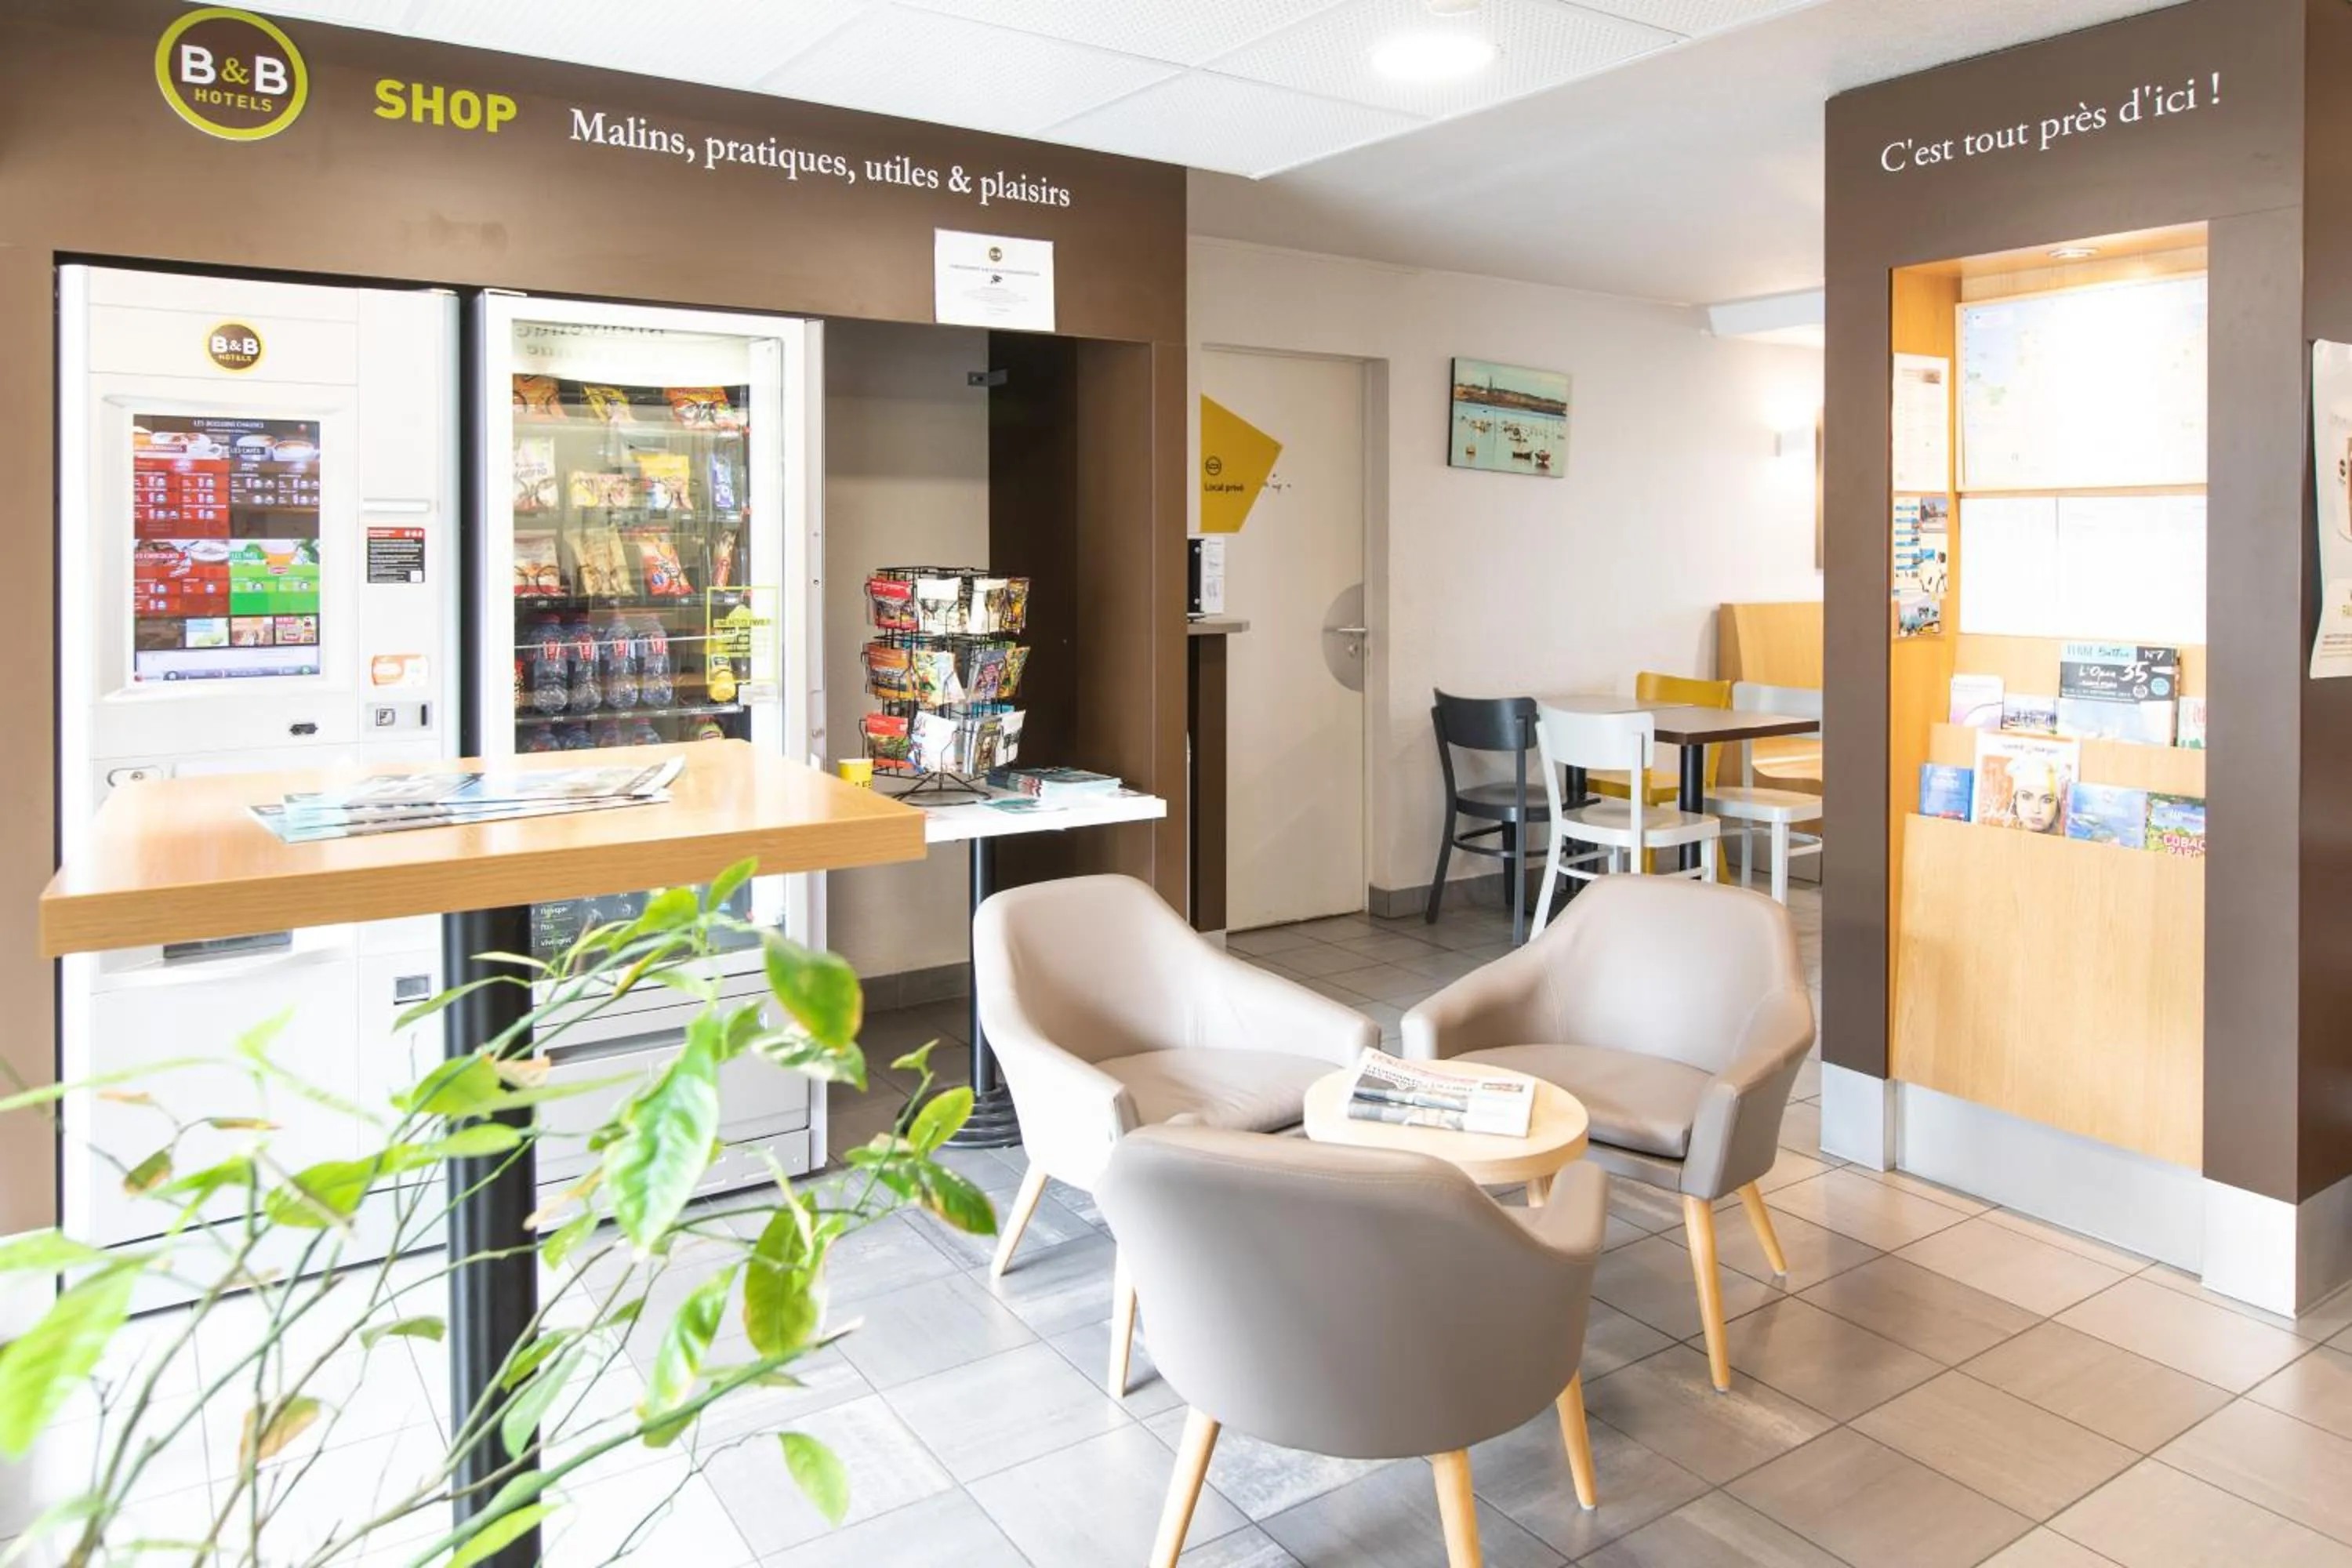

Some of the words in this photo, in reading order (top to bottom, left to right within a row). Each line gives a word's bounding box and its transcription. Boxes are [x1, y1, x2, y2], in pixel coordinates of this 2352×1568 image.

[194, 88, 272, 113] HOTELS
[375, 78, 518, 133] SHOP
[1881, 139, 1953, 172] C'est
[1964, 124, 2028, 155] tout
[2040, 102, 2107, 151] près
[2119, 79, 2196, 123] d'ici
[570, 108, 695, 162] Malins,
[705, 137, 855, 184] pratiques,
[865, 155, 938, 189] utiles
[948, 165, 971, 194] &
[980, 171, 1070, 206] plaisirs
[1204, 482, 1224, 492] Local
[1225, 483, 1245, 495] privé
